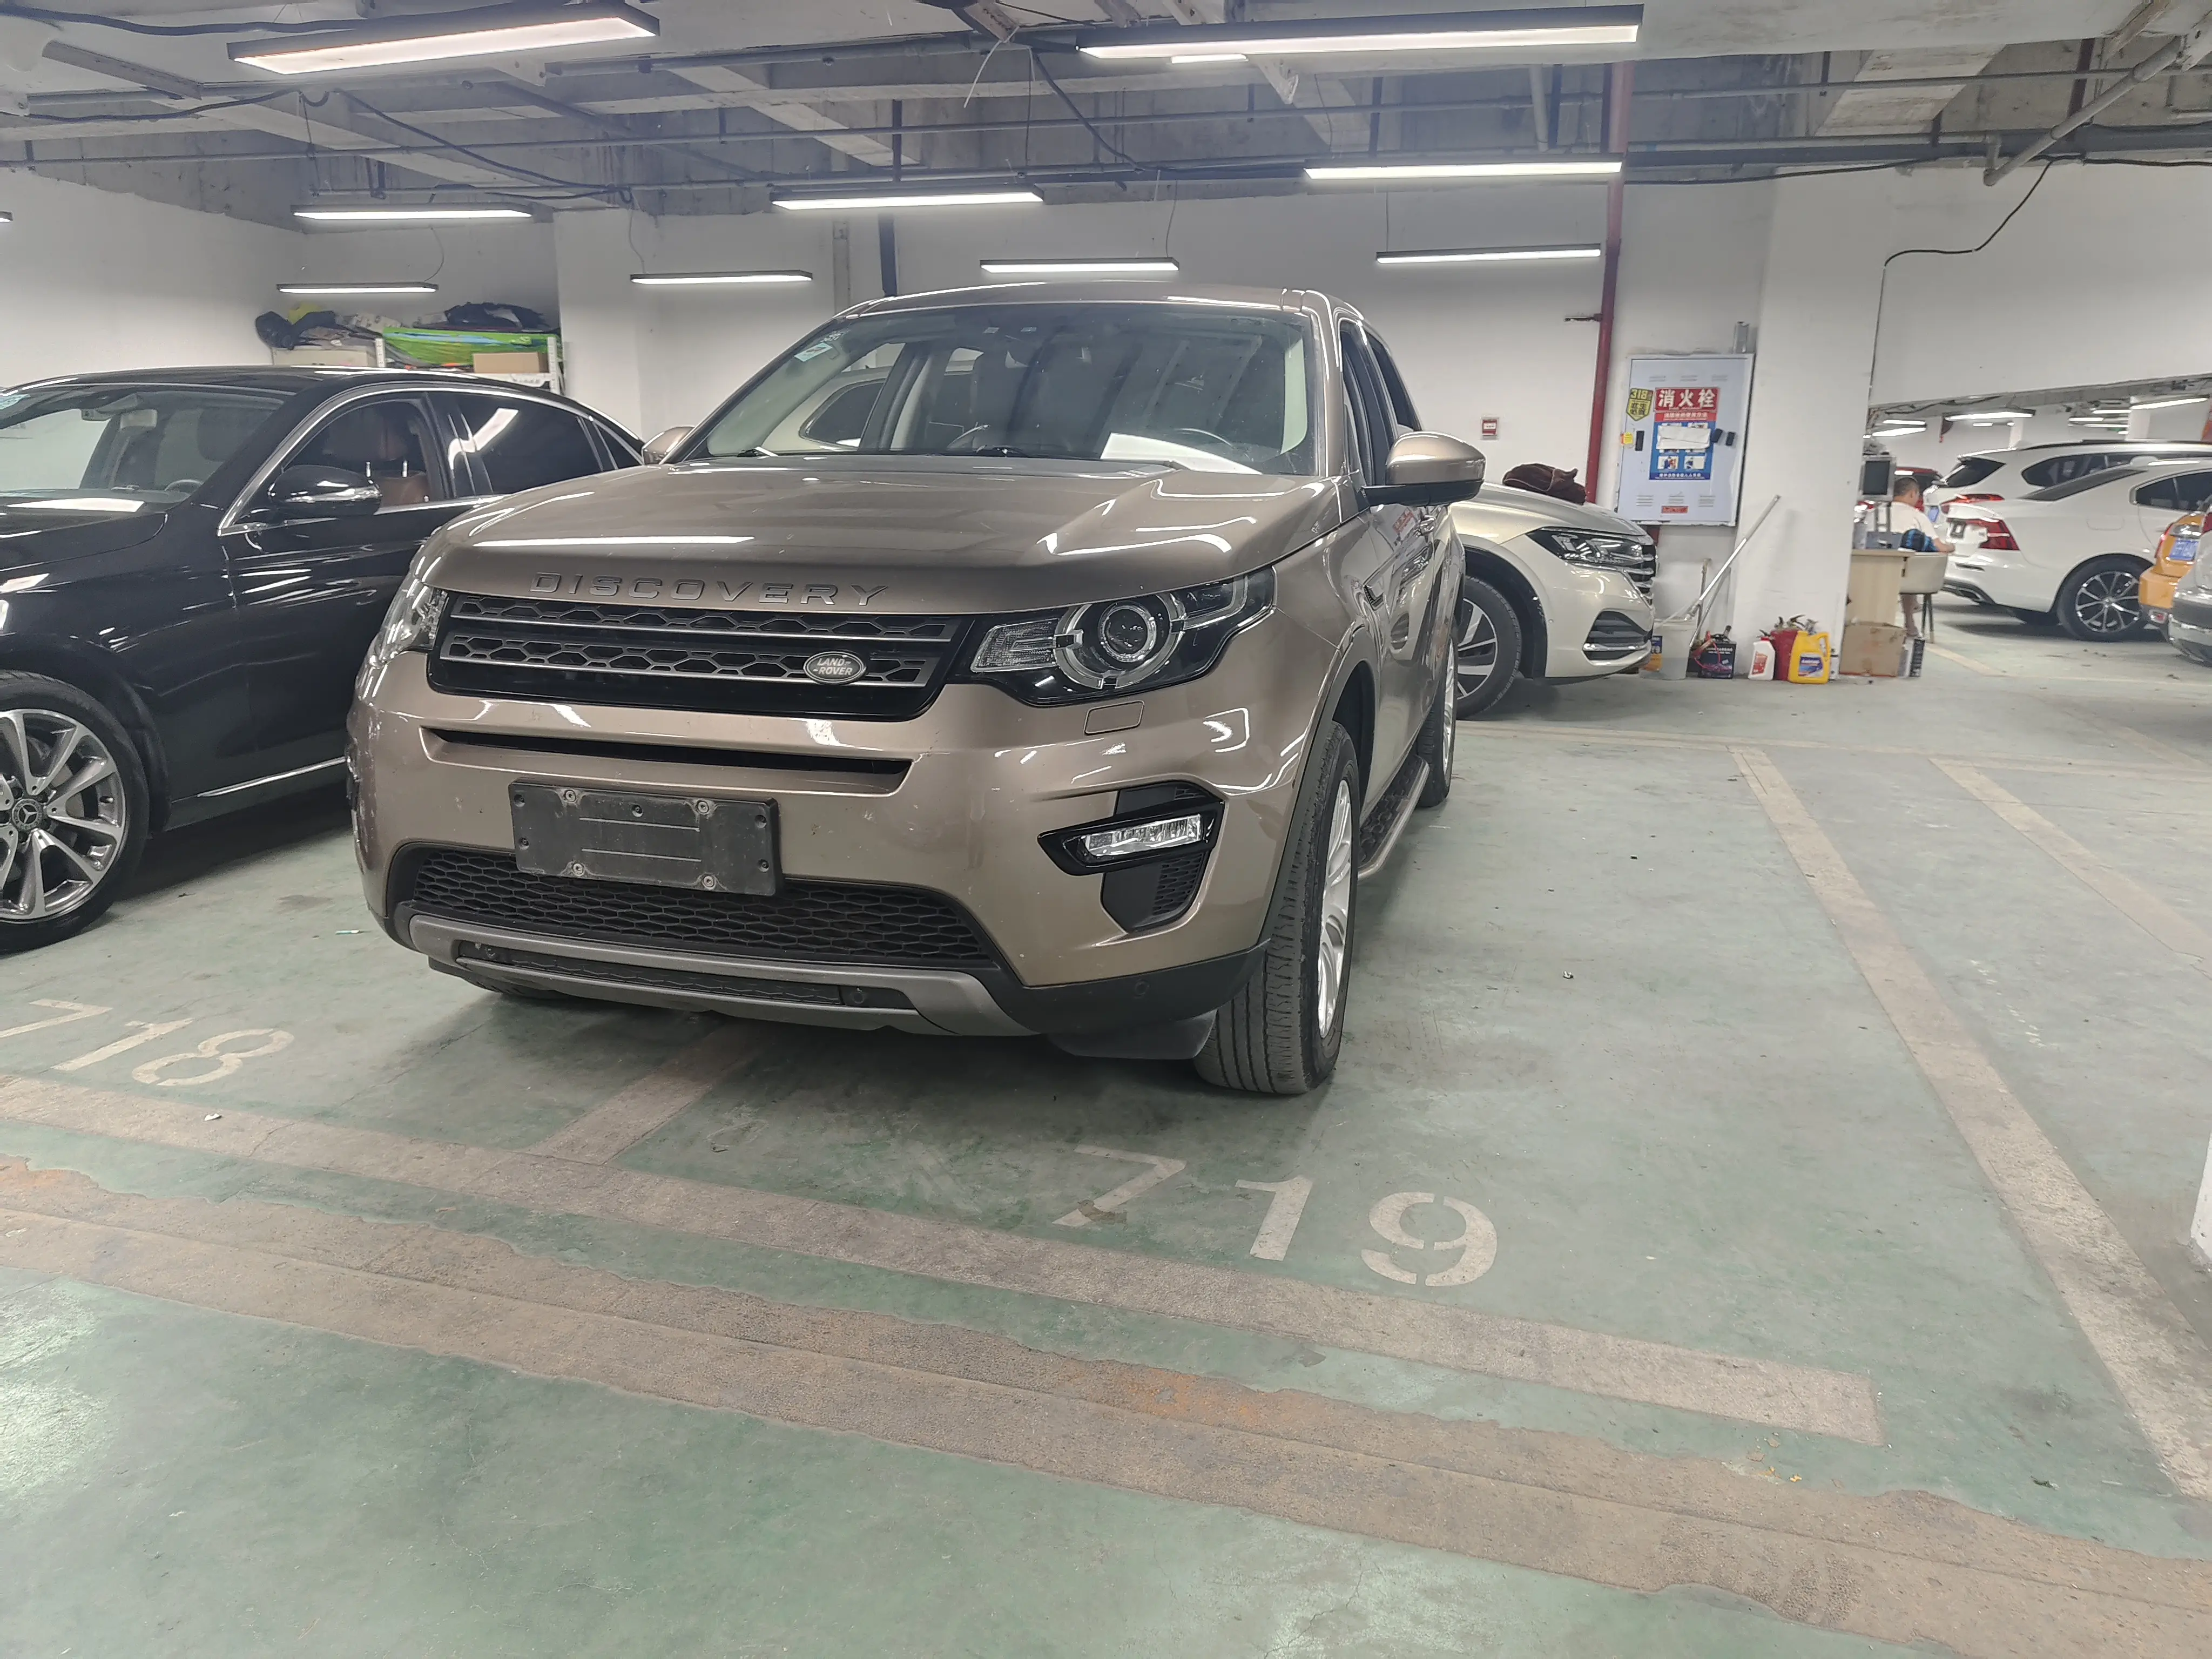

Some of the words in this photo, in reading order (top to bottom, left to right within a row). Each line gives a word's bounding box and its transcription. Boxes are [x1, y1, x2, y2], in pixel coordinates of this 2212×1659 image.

[1630, 389, 1648, 399] 318
[1658, 388, 1716, 408] 消火栓
[529, 571, 889, 606] DISCOVERY
[817, 658, 846, 666] LAND
[818, 666, 853, 675] ROVER
[0, 998, 295, 1087] 718
[1051, 1144, 1498, 1287] 719
